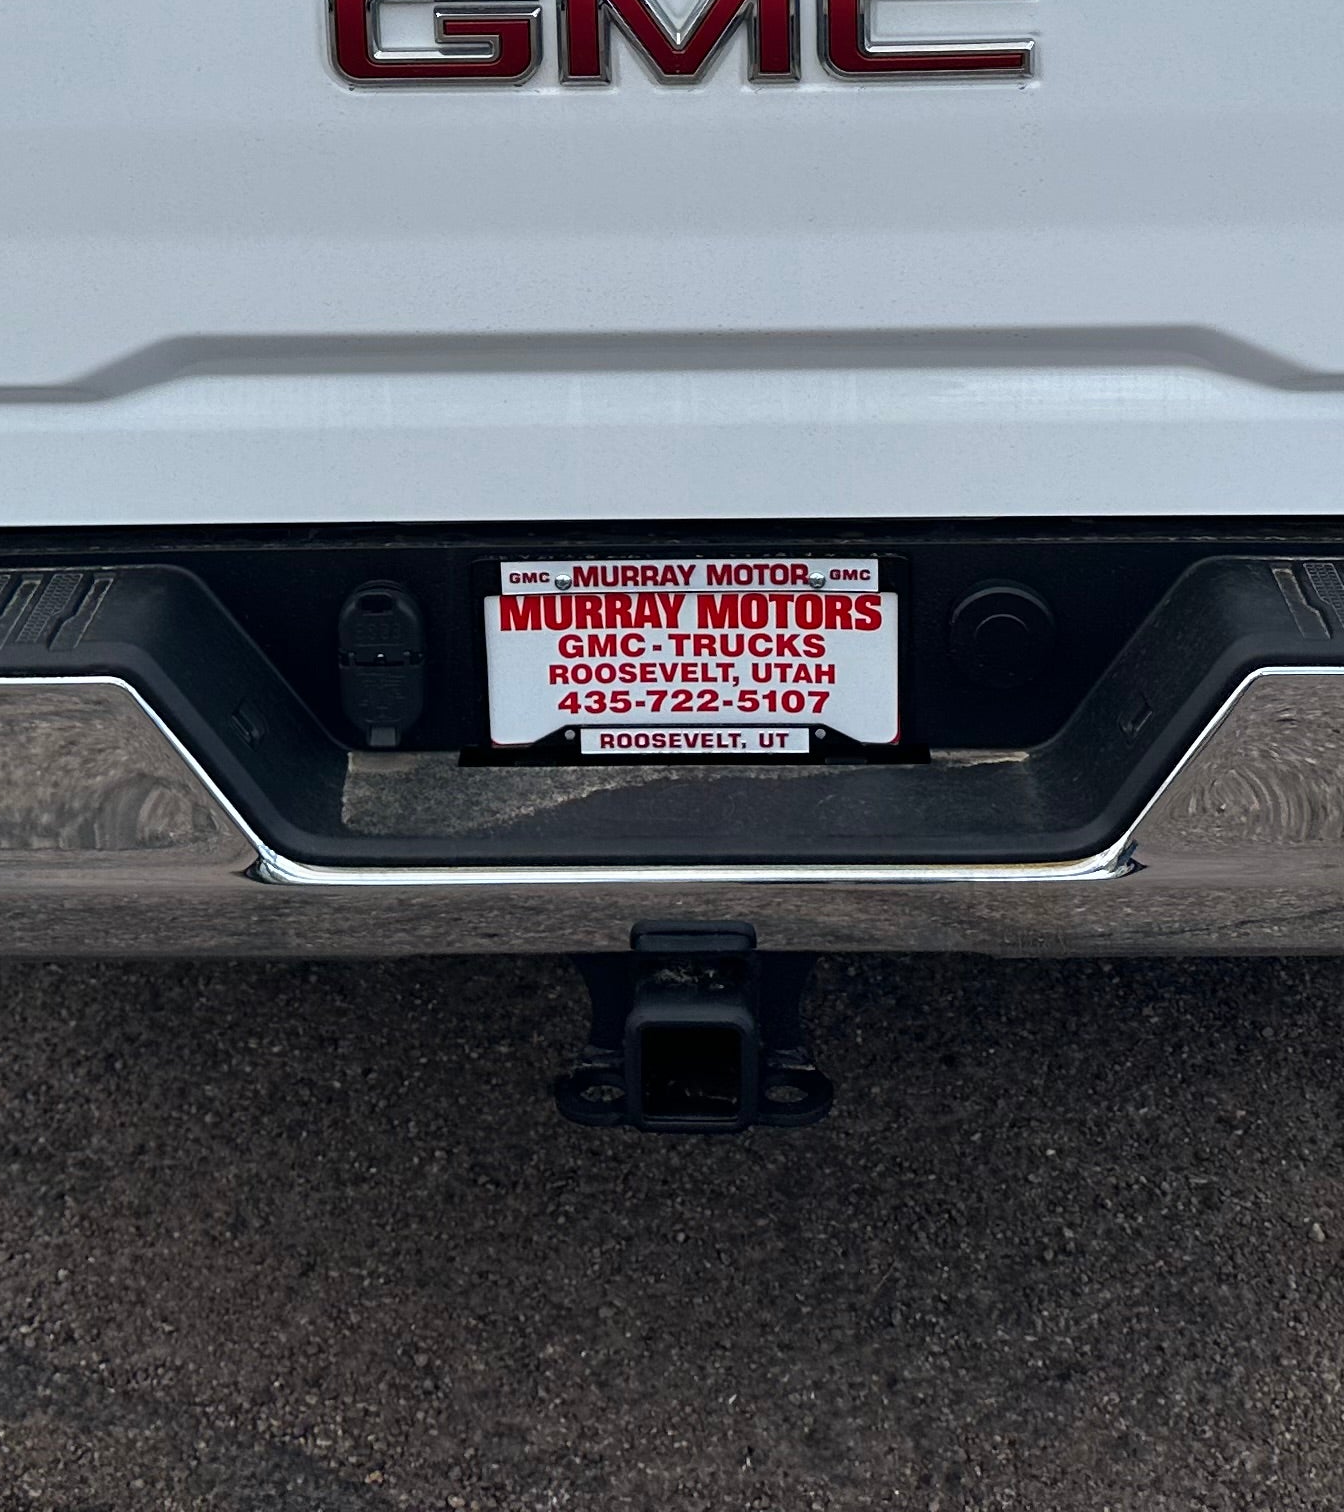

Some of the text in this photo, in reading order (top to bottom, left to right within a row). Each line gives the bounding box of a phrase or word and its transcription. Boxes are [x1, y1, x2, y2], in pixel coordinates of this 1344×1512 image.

[508, 563, 871, 587] GMC MURRAY MOTOR GMC
[500, 593, 883, 631] MURRAY MOTORS
[549, 663, 836, 688] ROOSEVELT, UTAH
[558, 689, 830, 714] 435-722-5107
[600, 732, 789, 749] ROOSEVELT, UT
